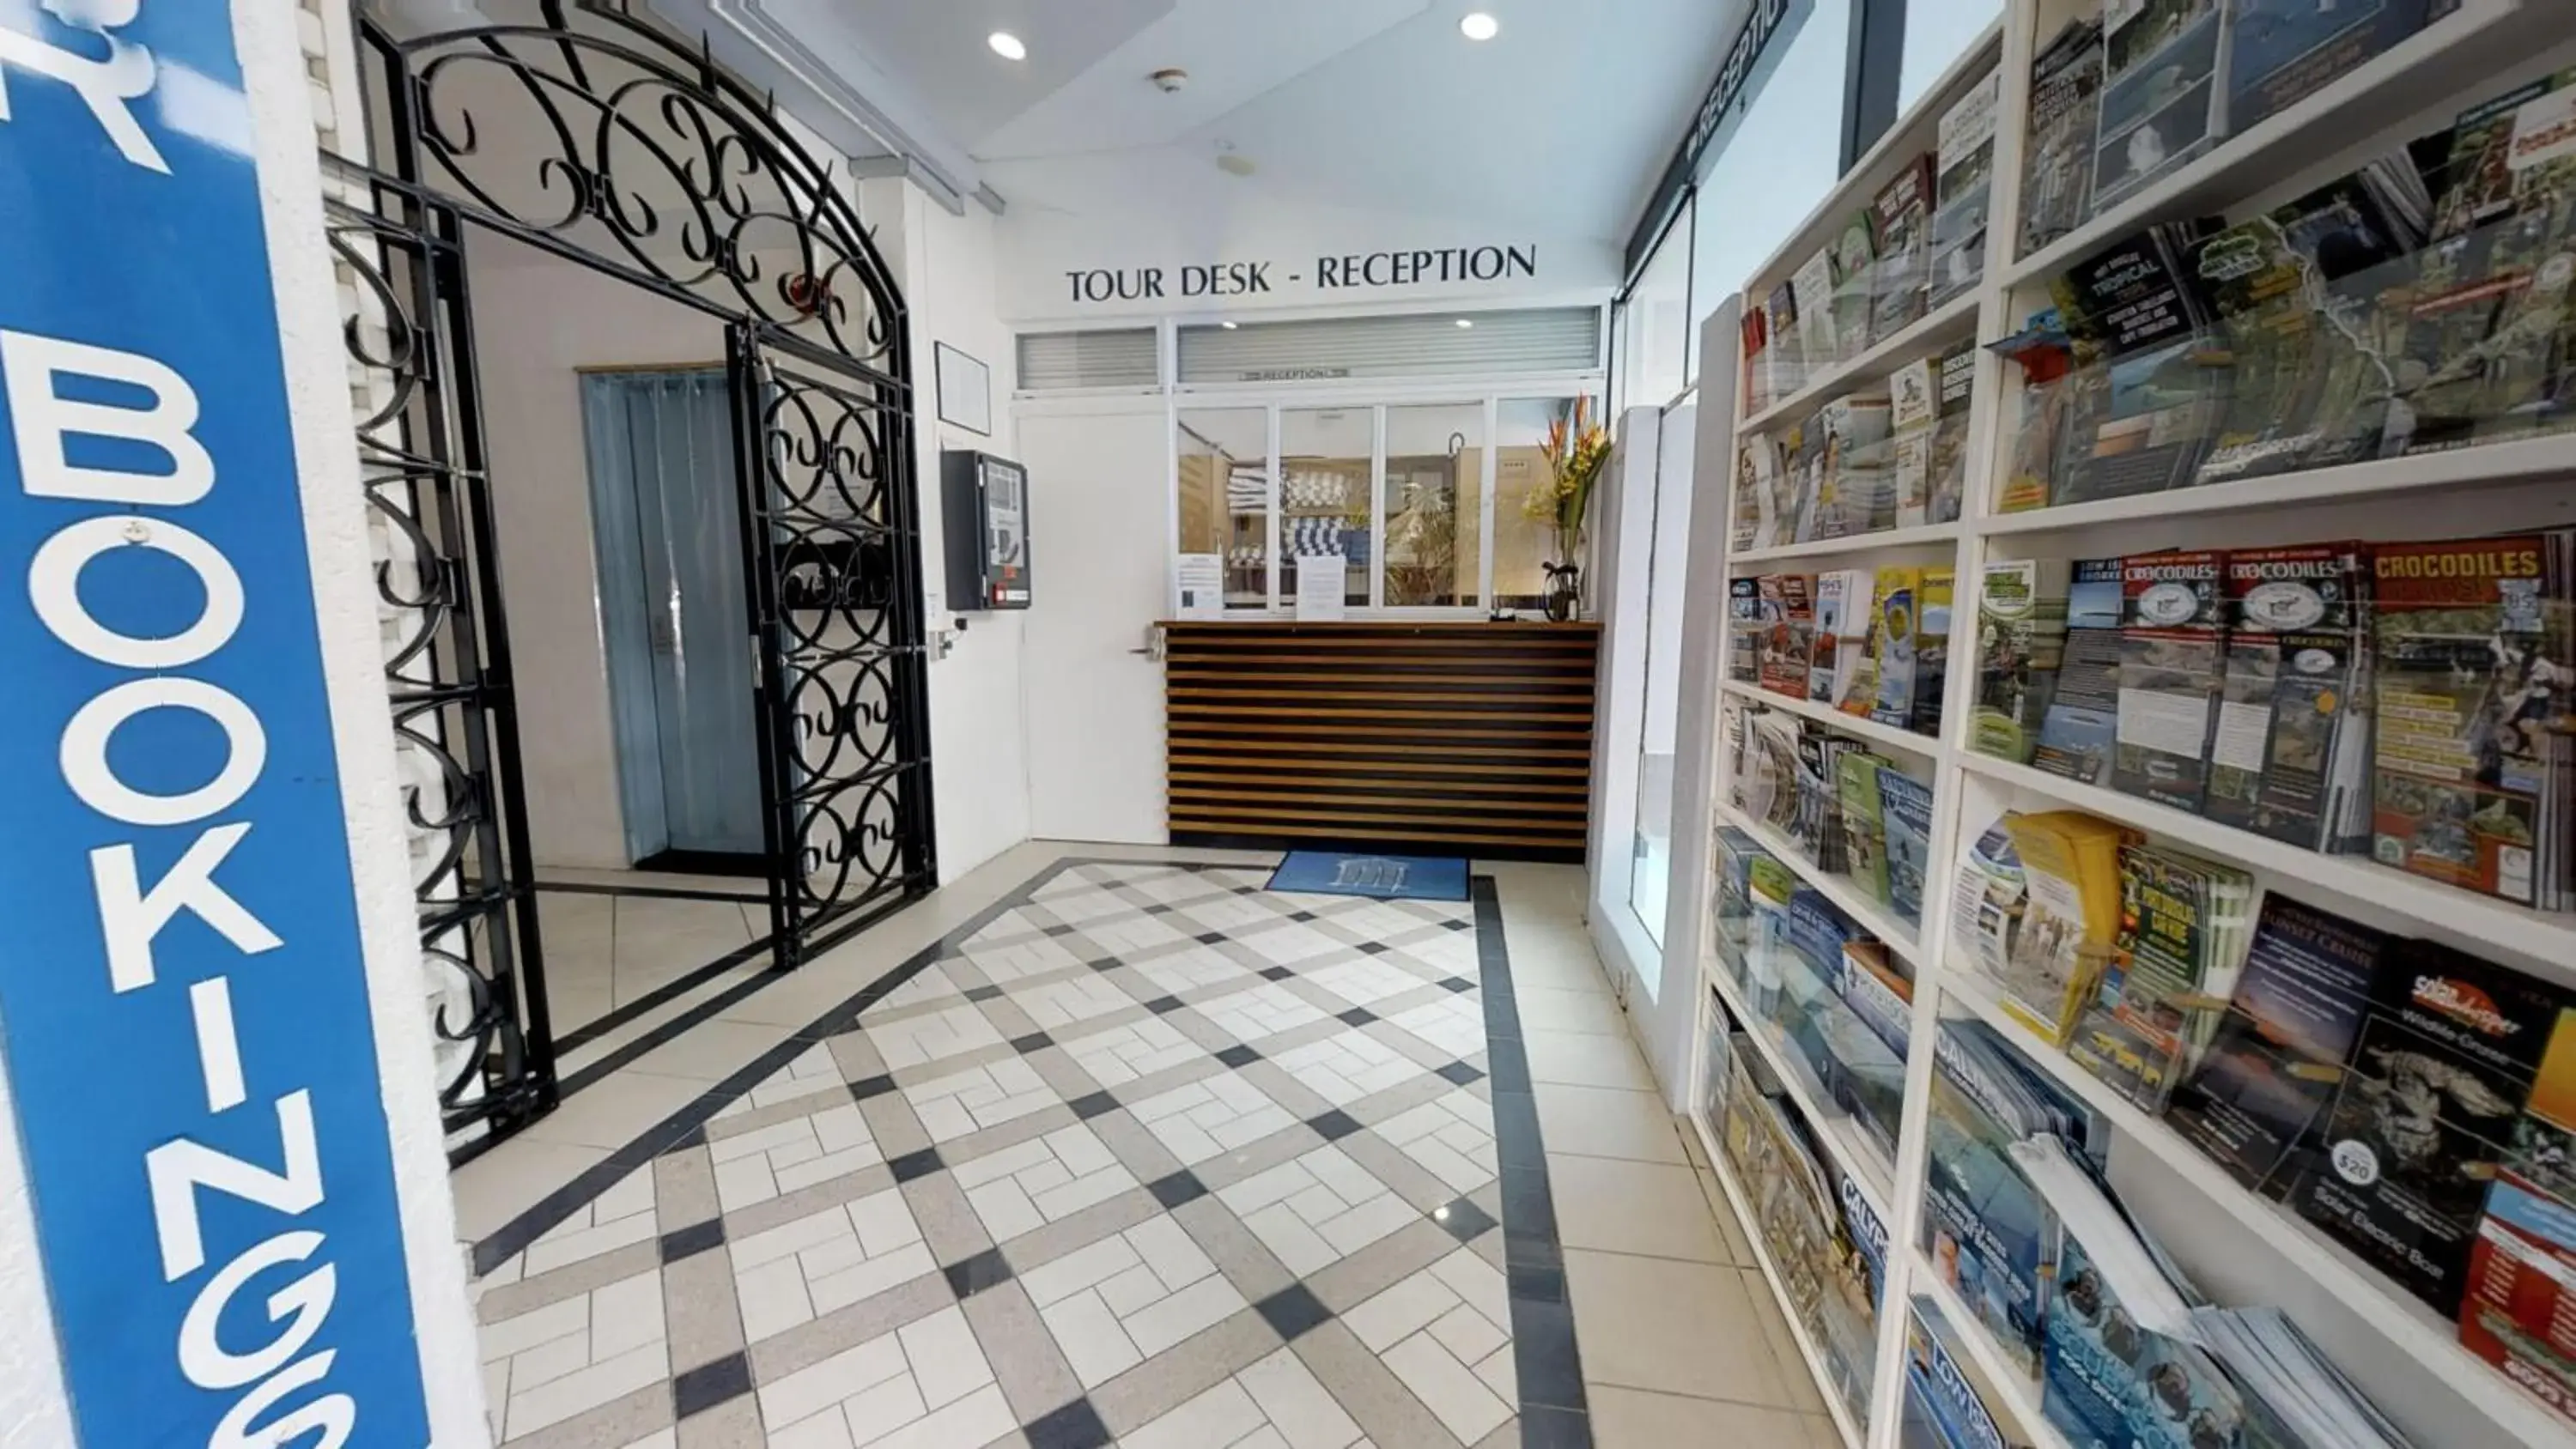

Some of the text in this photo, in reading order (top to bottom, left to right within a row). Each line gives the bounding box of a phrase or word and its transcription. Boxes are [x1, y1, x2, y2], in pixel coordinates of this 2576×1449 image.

[1066, 266, 1163, 302] TOUR
[1182, 261, 1270, 296] DESK
[1317, 245, 1536, 287] RECEPTION
[2125, 563, 2215, 581] CROCODILES
[2230, 561, 2337, 579] CROCODILES
[2376, 551, 2539, 578] CROCODILES
[0, 330, 356, 1449] BOOKINGS
[2338, 1153, 2370, 1180] $20
